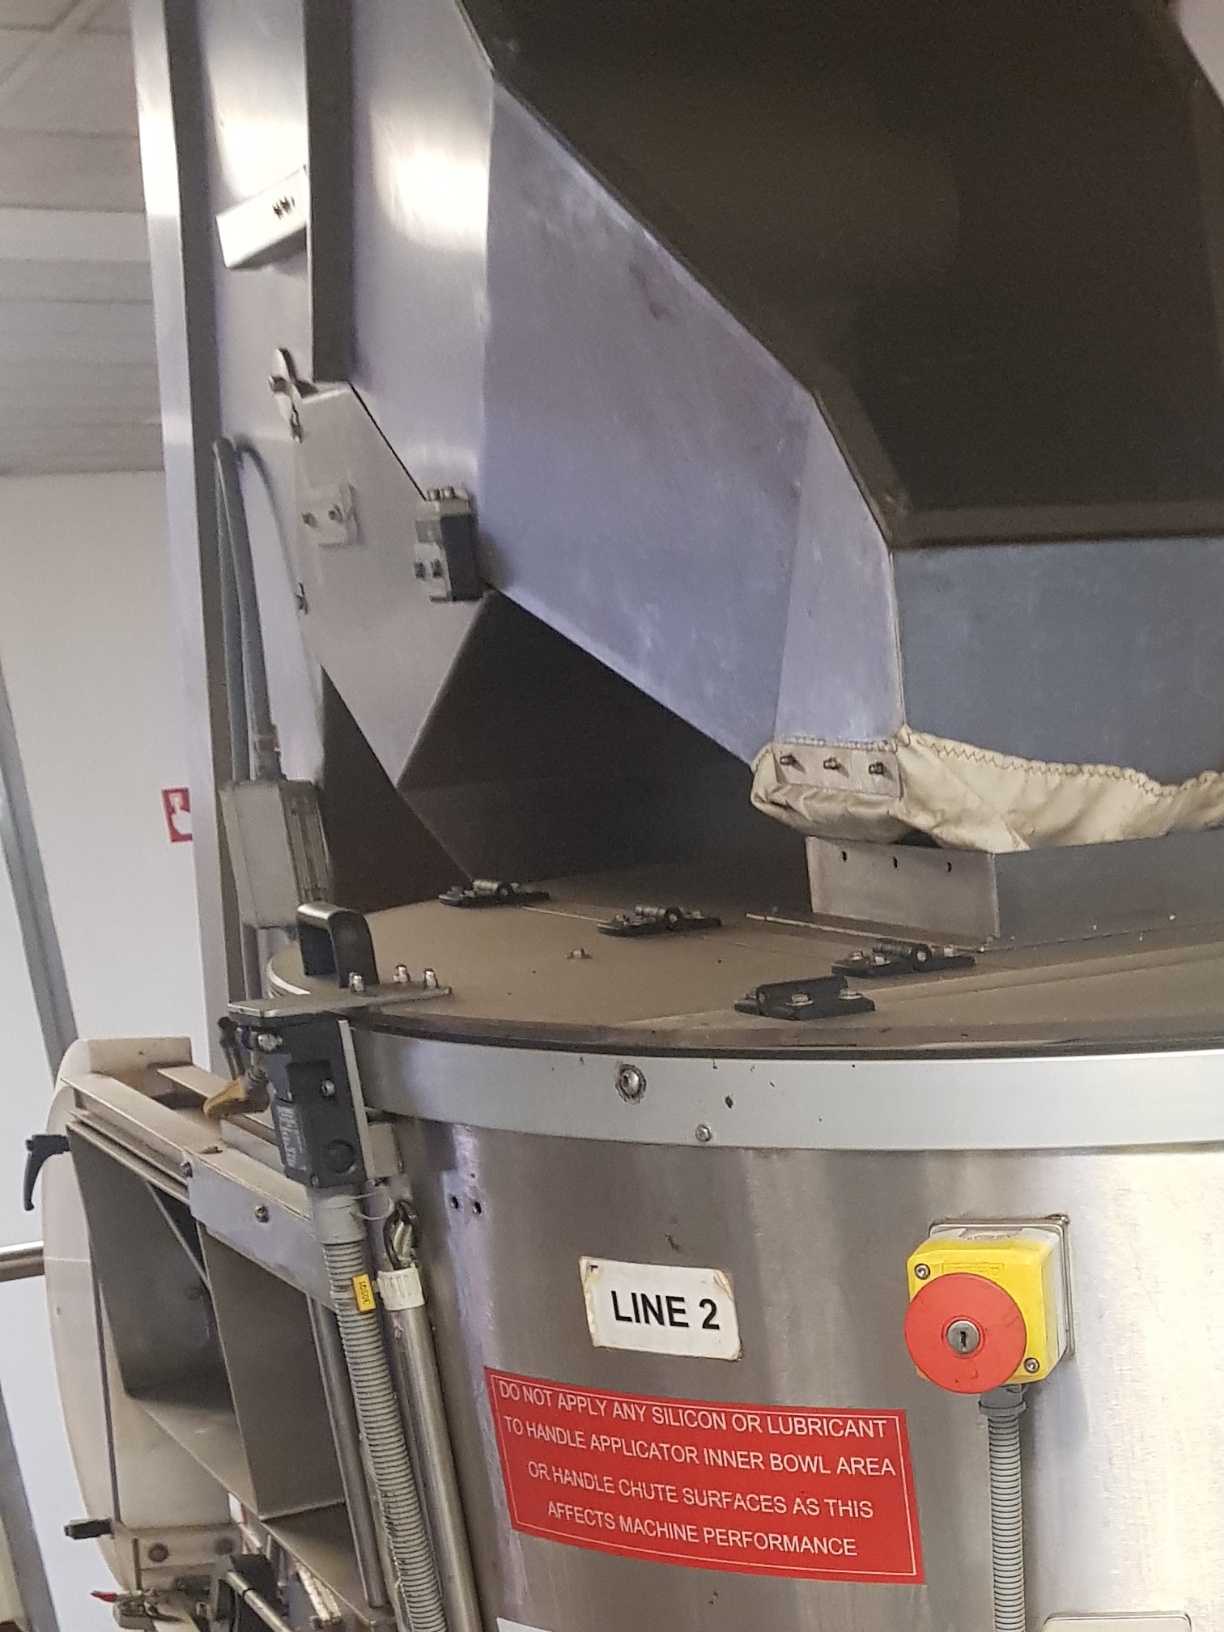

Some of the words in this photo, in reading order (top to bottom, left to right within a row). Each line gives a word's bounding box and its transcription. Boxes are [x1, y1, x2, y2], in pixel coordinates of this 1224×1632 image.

[611, 1290, 690, 1328] LINE
[699, 1298, 720, 1330] 2
[499, 1380, 520, 1400] DO
[523, 1385, 552, 1407] NOT
[557, 1393, 607, 1417] APPLY
[612, 1401, 647, 1422] ANY
[651, 1406, 727, 1430] SILICON
[731, 1413, 763, 1433] OR
[767, 1415, 887, 1438] LUBRICANT
[503, 1415, 524, 1436] TO
[526, 1422, 587, 1449] HANDLE
[590, 1434, 700, 1465] APPLICATOR
[703, 1448, 766, 1470] INNER
[769, 1453, 832, 1474] BOWL
[836, 1456, 897, 1476] AREA
[527, 1460, 551, 1481] OR
[551, 1465, 616, 1494] HANDLE
[618, 1478, 679, 1504] CHUTE
[682, 1487, 787, 1514] SURFACES
[792, 1497, 820, 1516] AS
[824, 1498, 874, 1519] THIS
[548, 1501, 616, 1530] AFFECTS
[619, 1514, 700, 1543] MACHINE
[703, 1527, 858, 1557] PERFORMANCE
